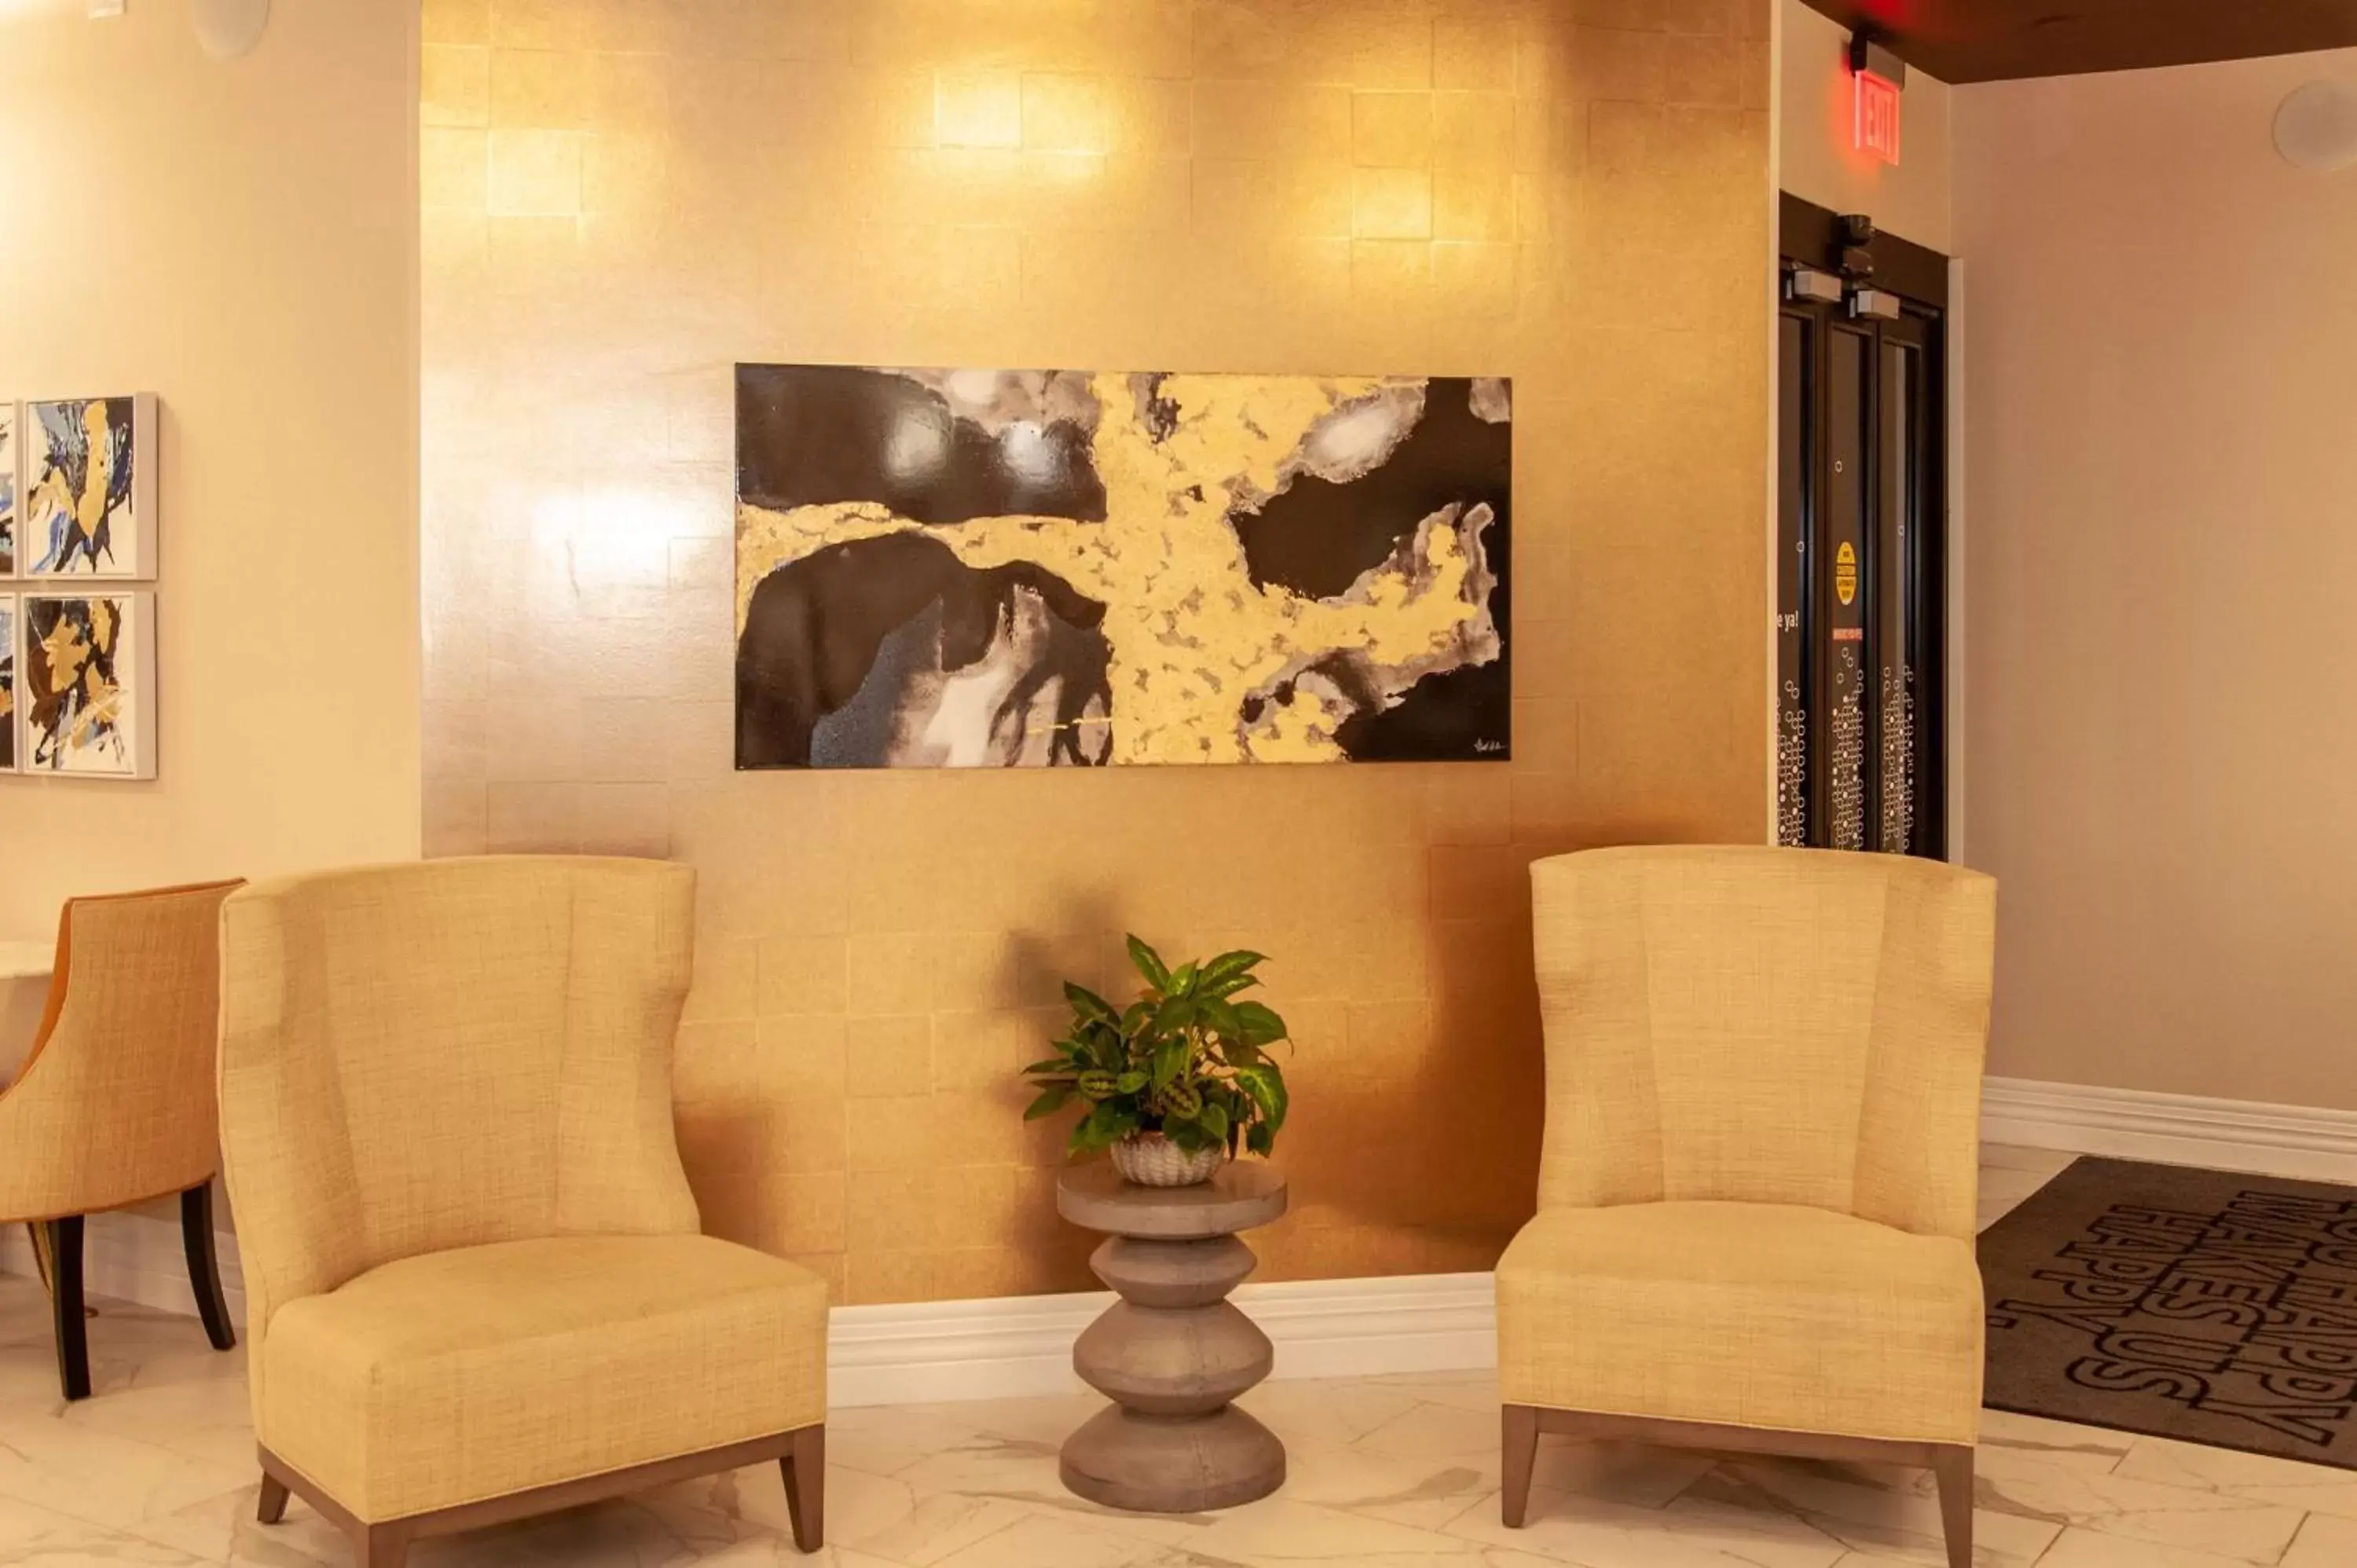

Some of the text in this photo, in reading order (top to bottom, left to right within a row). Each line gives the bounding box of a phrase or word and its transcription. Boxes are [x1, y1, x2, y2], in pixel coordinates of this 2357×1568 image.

[1864, 85, 1892, 154] EXIT
[1784, 610, 1799, 632] ya!
[2066, 1190, 2340, 1408] MAKES US
